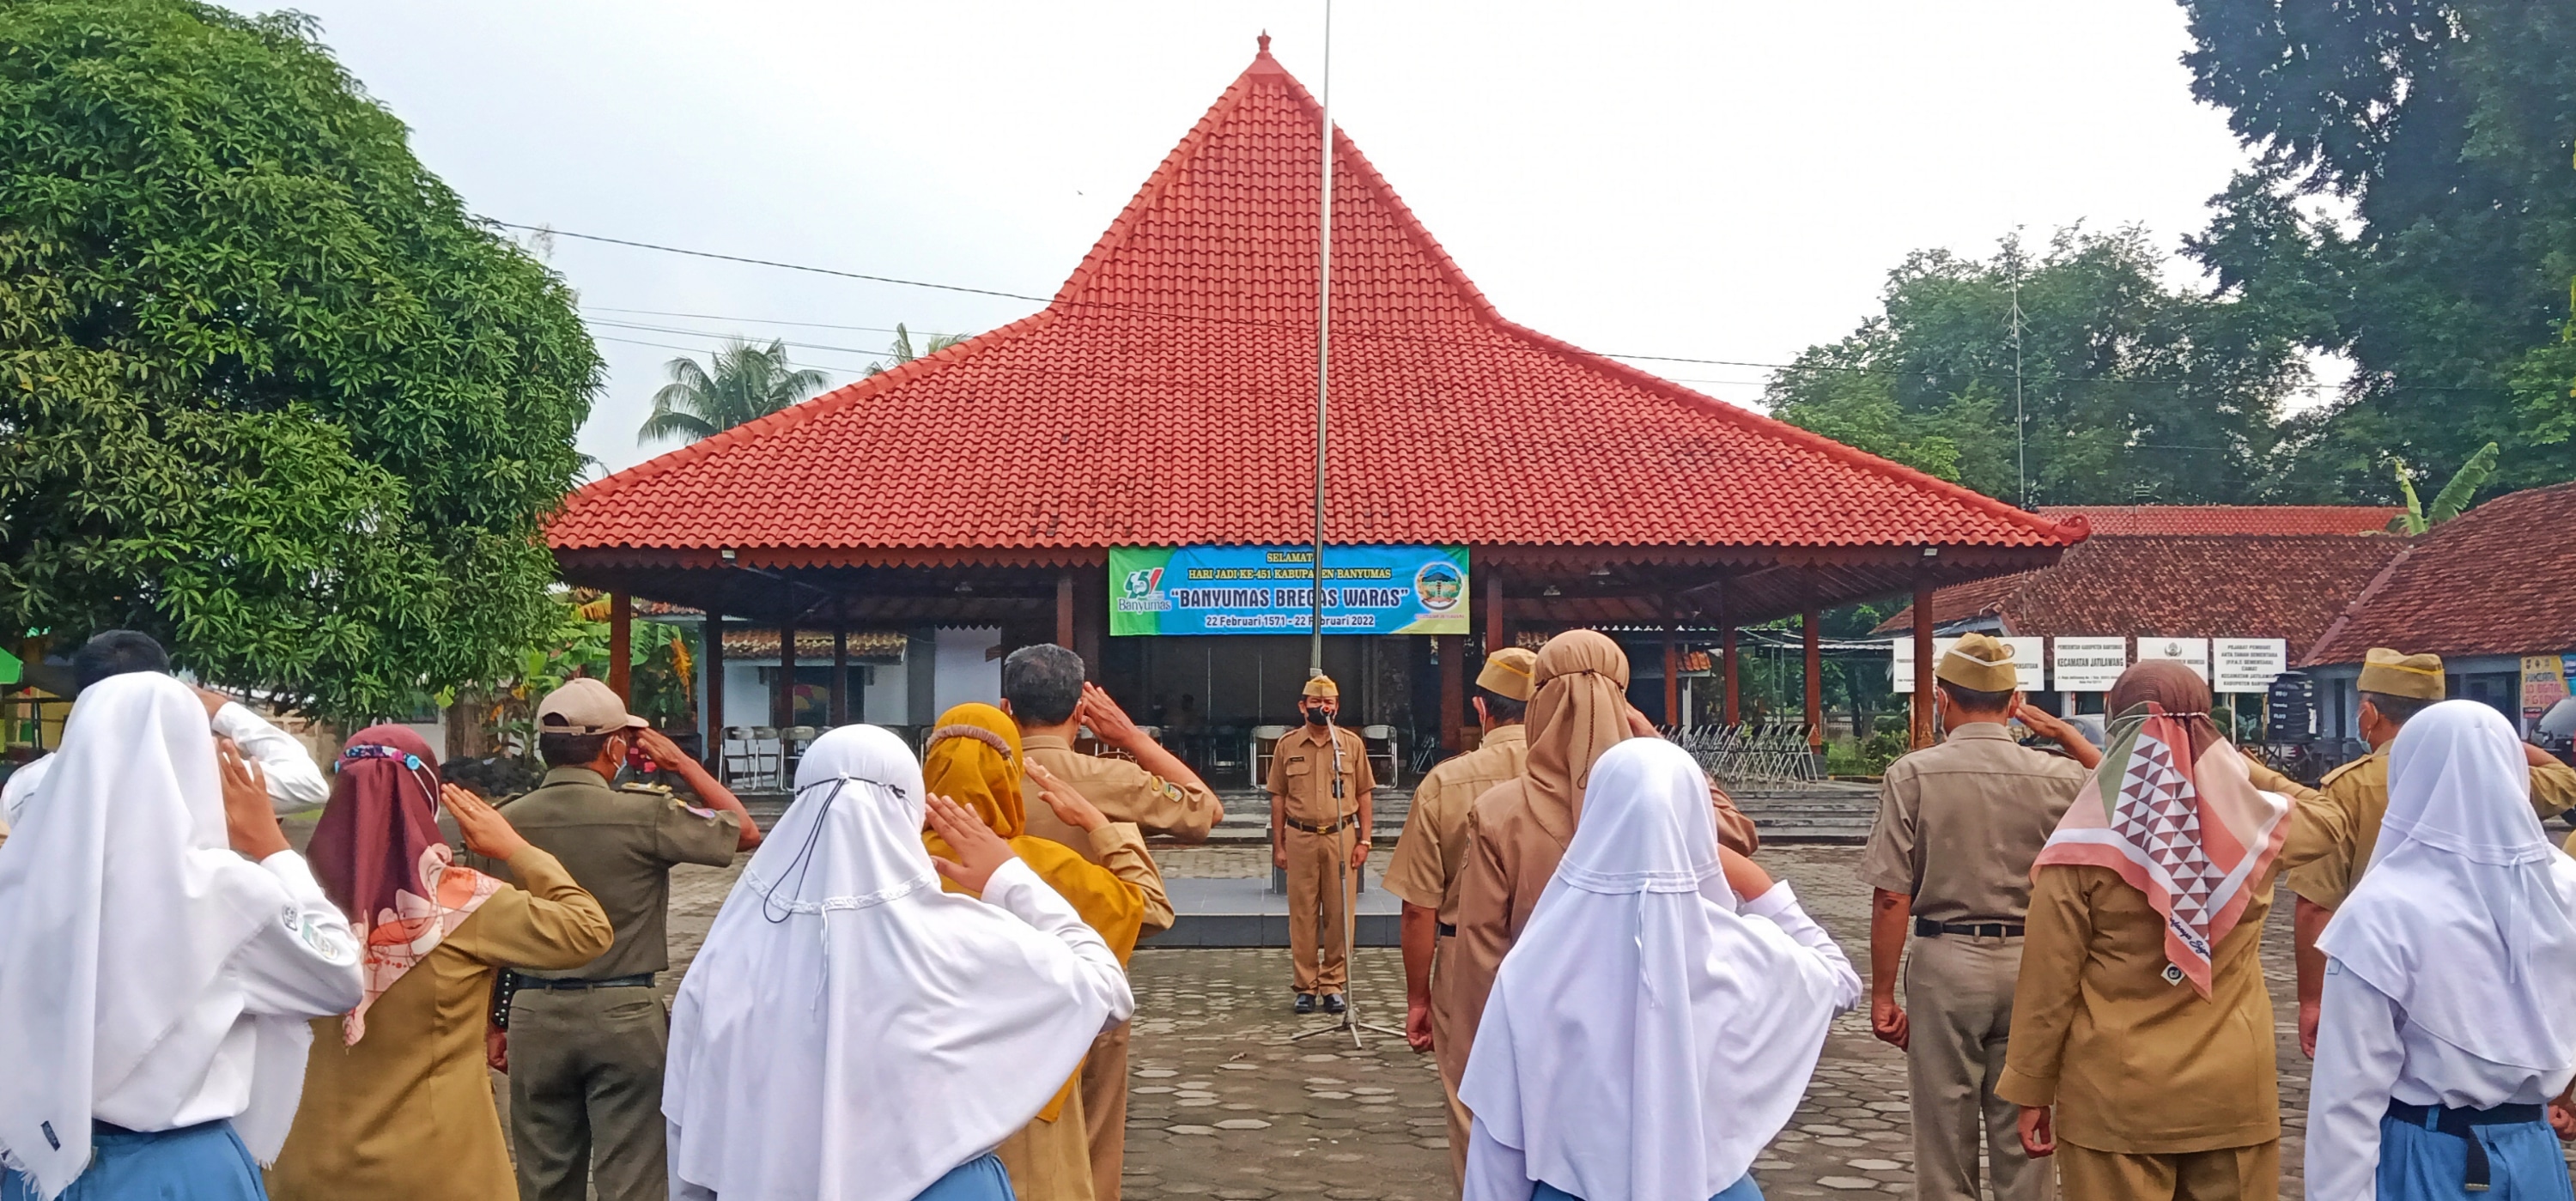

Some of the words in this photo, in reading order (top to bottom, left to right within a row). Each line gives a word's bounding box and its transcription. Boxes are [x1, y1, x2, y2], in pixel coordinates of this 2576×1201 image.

[1267, 553, 1313, 562] SELAMAT
[1188, 569, 1212, 579] HARI
[1215, 569, 1237, 579] JADI
[1239, 569, 1271, 579] KE-451
[1274, 569, 1334, 579] KABUPAEN
[1336, 569, 1391, 579] BANYUMAS
[1118, 598, 1171, 613] Banyumas
[1206, 616, 1218, 626] 22
[1220, 616, 1261, 626] Februari
[1264, 616, 1285, 626] 1571
[1295, 616, 1306, 626] 22
[1308, 616, 1349, 626] Fbruari
[1351, 616, 1374, 626] 2022
[2057, 658, 2089, 667] KECAMATAN
[2090, 658, 2123, 667] JATILAWANG
